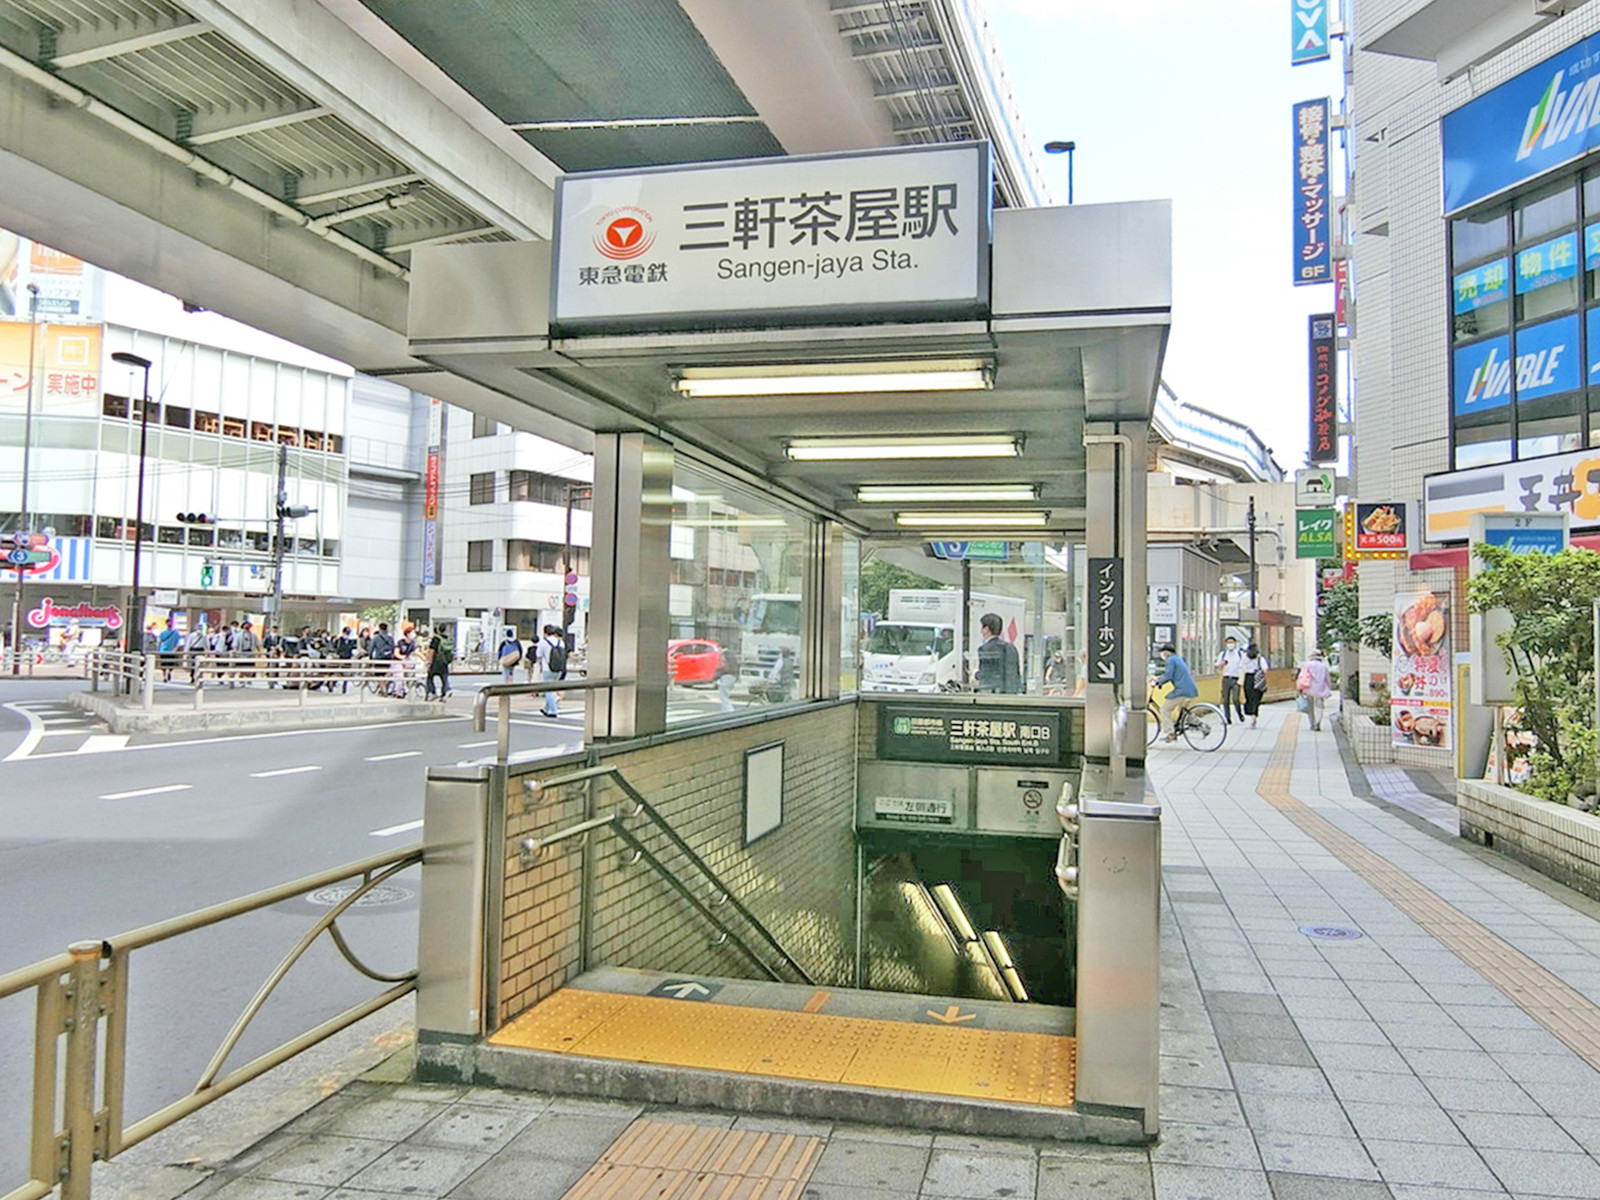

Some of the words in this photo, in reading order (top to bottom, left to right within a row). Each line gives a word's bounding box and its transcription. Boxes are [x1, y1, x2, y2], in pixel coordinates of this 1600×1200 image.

[679, 183, 959, 251] 三軒茶屋駅
[578, 262, 668, 285] 東急電鉄
[717, 253, 863, 282] Sangen-jaya
[872, 250, 919, 271] Sta.
[1302, 265, 1325, 278] 6F
[47, 374, 96, 395] 実施中
[1299, 519, 1333, 531] レイク
[1300, 532, 1333, 543] ALSA
[1098, 562, 1115, 656] インターホン
[950, 720, 1017, 738] 三軒茶屋駅
